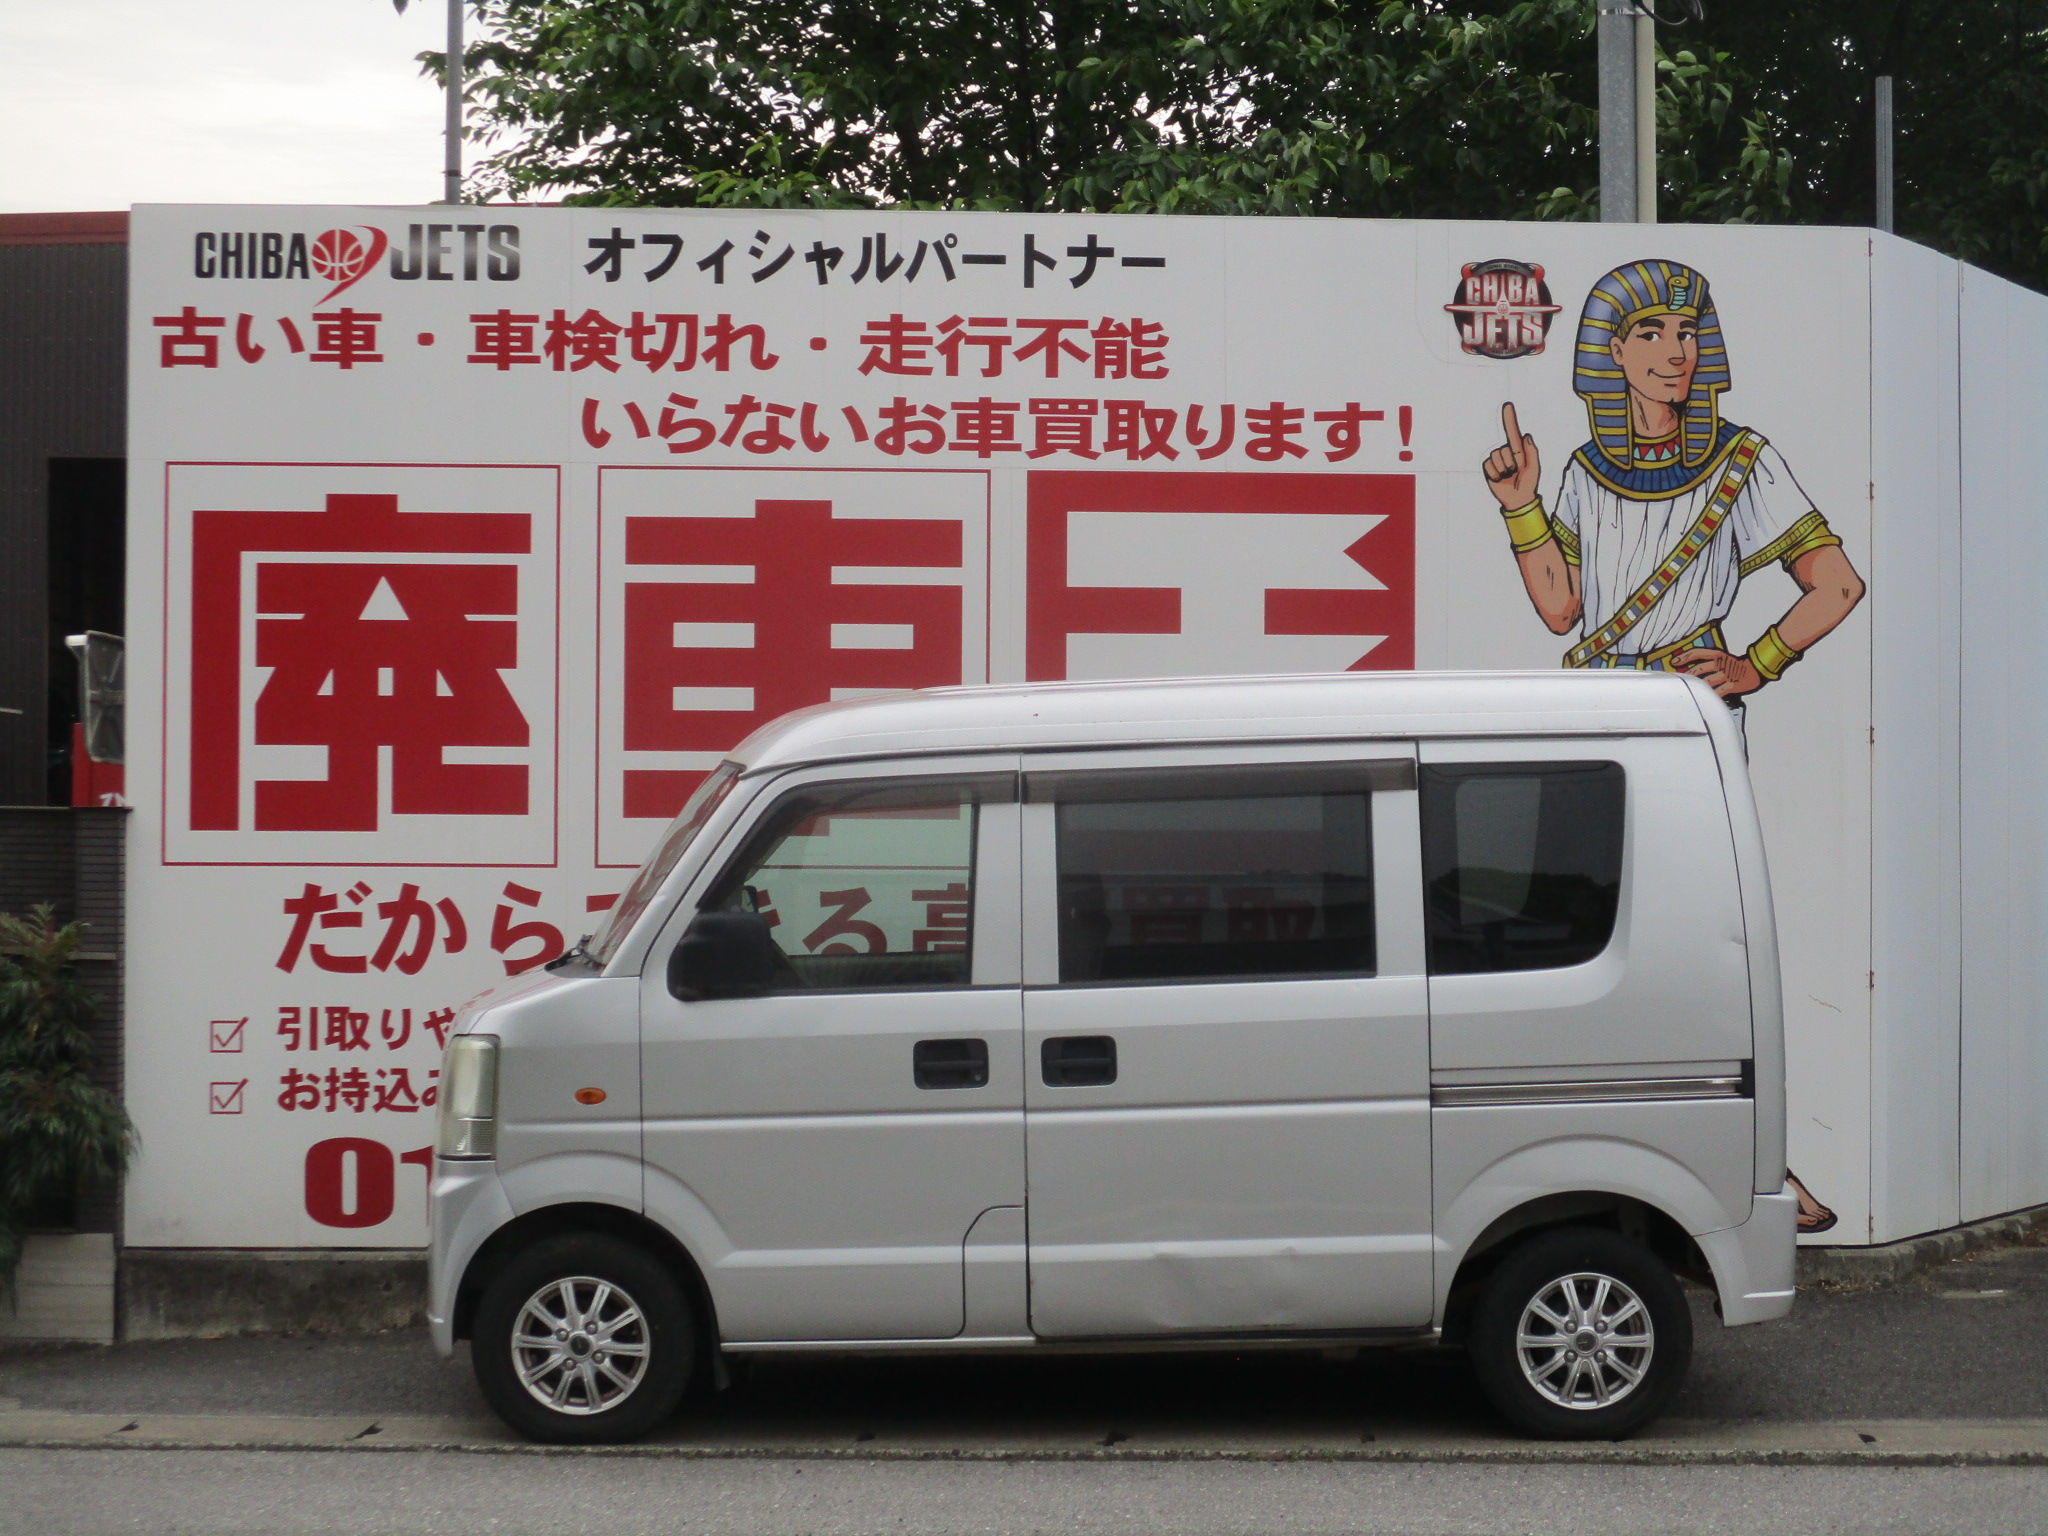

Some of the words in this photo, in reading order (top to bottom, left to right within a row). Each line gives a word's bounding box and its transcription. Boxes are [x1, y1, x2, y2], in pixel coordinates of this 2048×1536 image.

[195, 232, 310, 280] CHIBA
[389, 223, 520, 282] JETS
[584, 227, 1166, 289] オフィシャルパートナー
[1466, 273, 1539, 304] CHIBA
[1463, 312, 1542, 348] JETS
